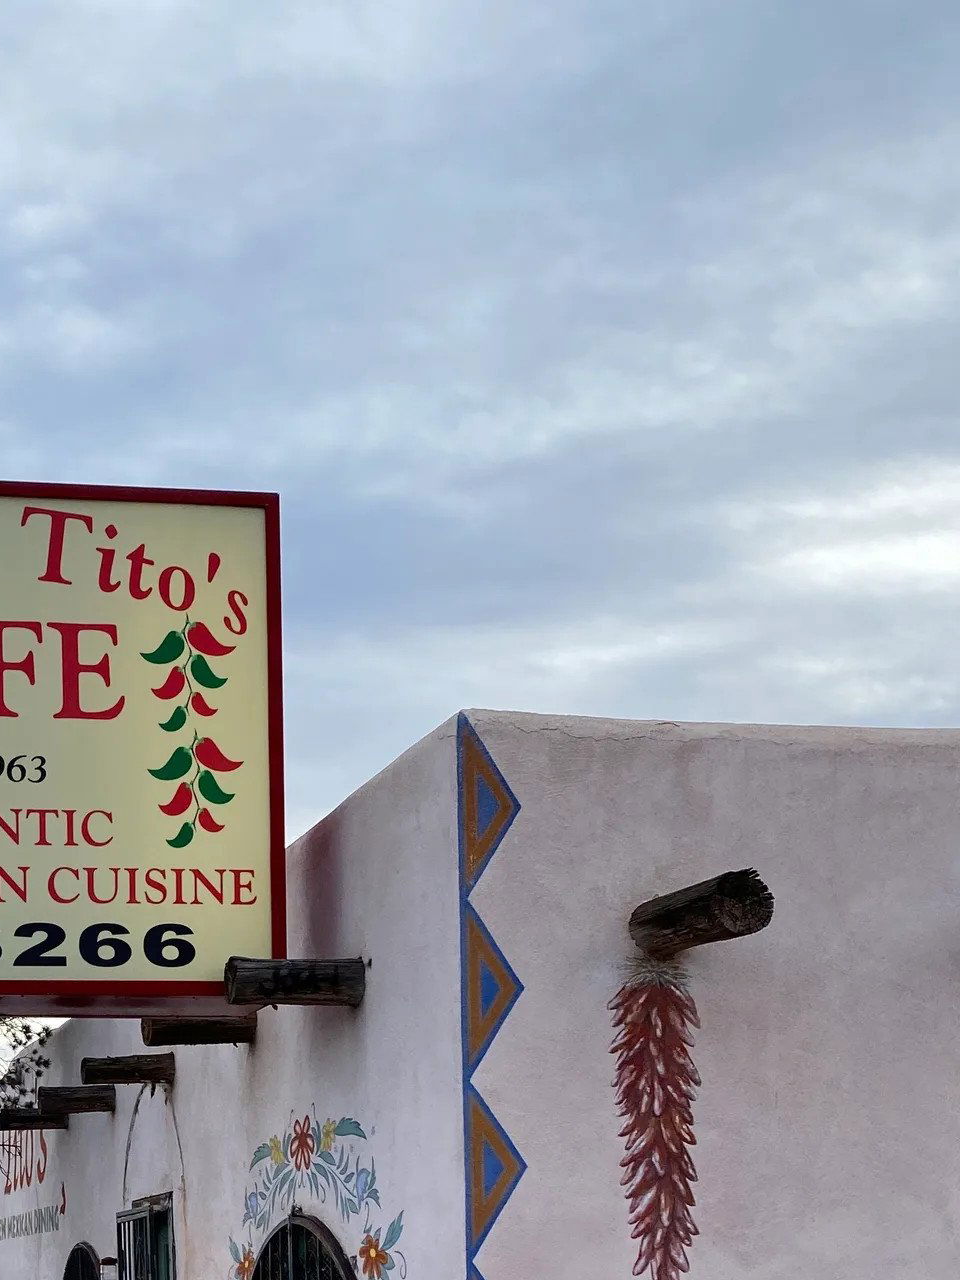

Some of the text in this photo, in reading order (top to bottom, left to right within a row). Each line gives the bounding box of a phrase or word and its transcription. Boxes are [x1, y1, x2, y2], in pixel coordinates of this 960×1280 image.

[20, 506, 249, 636] Tito's
[47, 866, 257, 906] CUISINE
[33, 1204, 60, 1234] DINING
